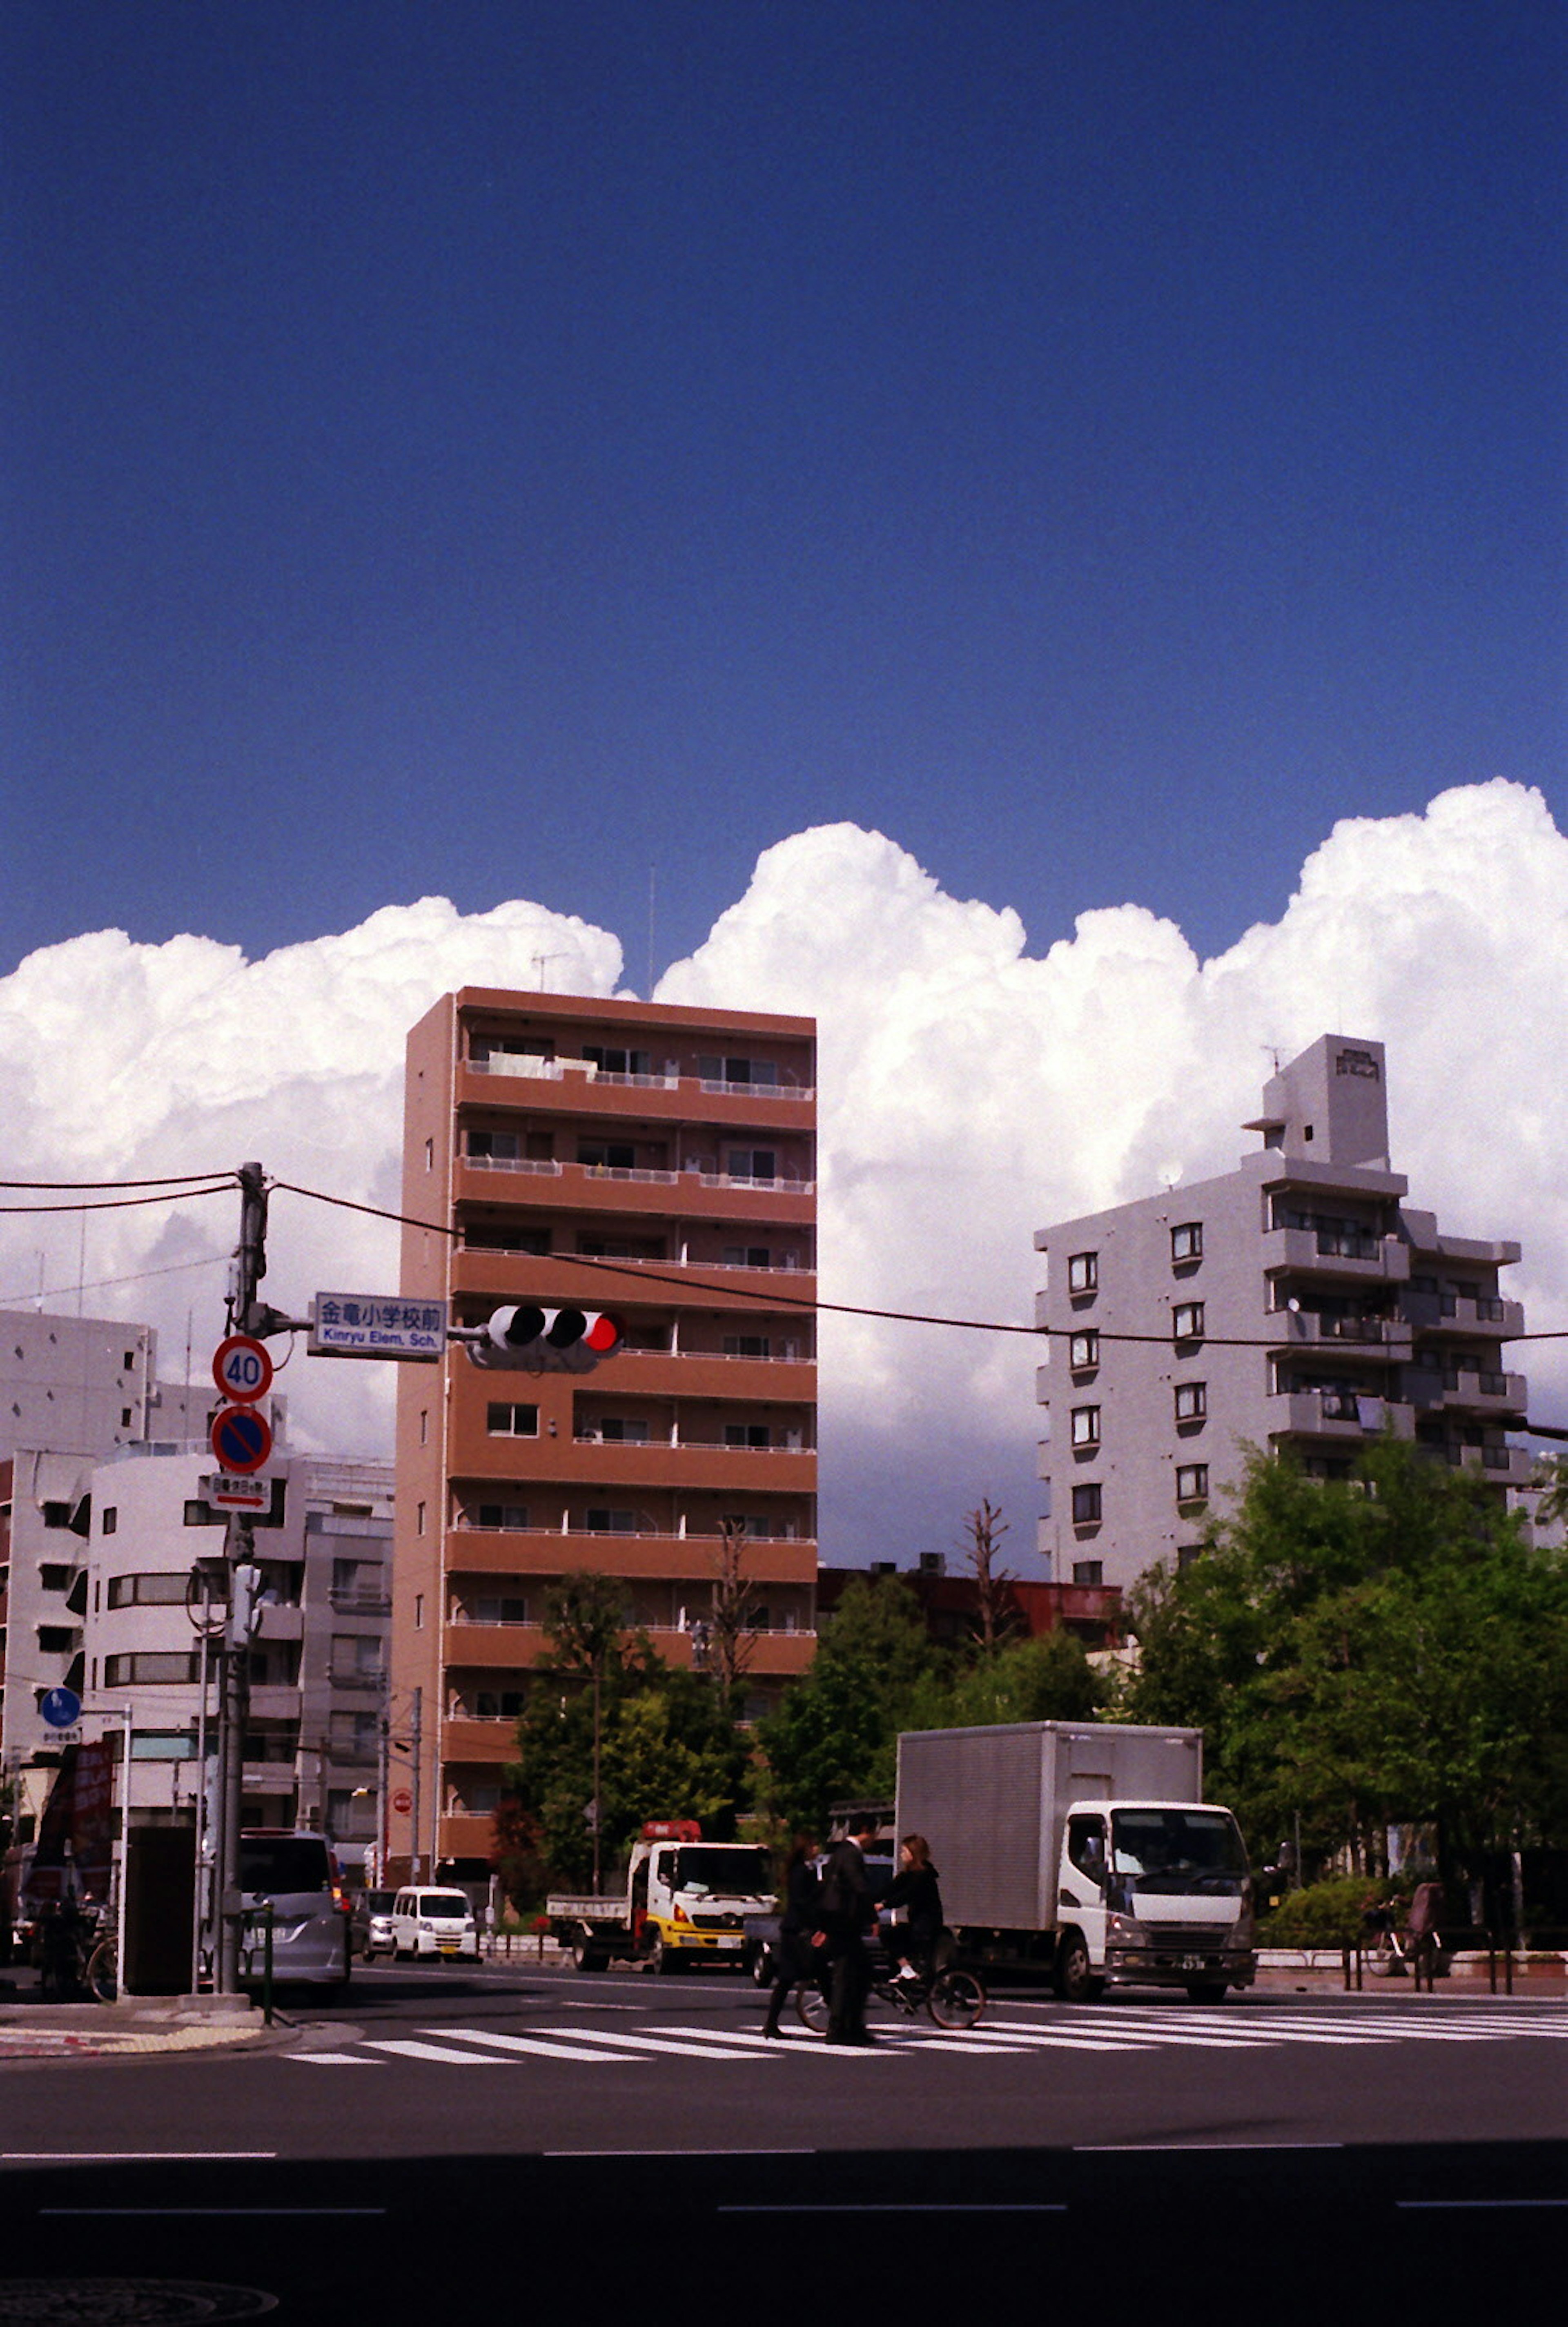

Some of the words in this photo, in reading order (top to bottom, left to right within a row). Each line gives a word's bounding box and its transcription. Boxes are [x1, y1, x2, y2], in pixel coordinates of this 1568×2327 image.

[322, 1301, 440, 1332] 金竜小学校前
[324, 1329, 364, 1344] Kinryu
[370, 1330, 404, 1345] Elem.
[410, 1333, 437, 1347] Sch.
[227, 1355, 259, 1385] 40
